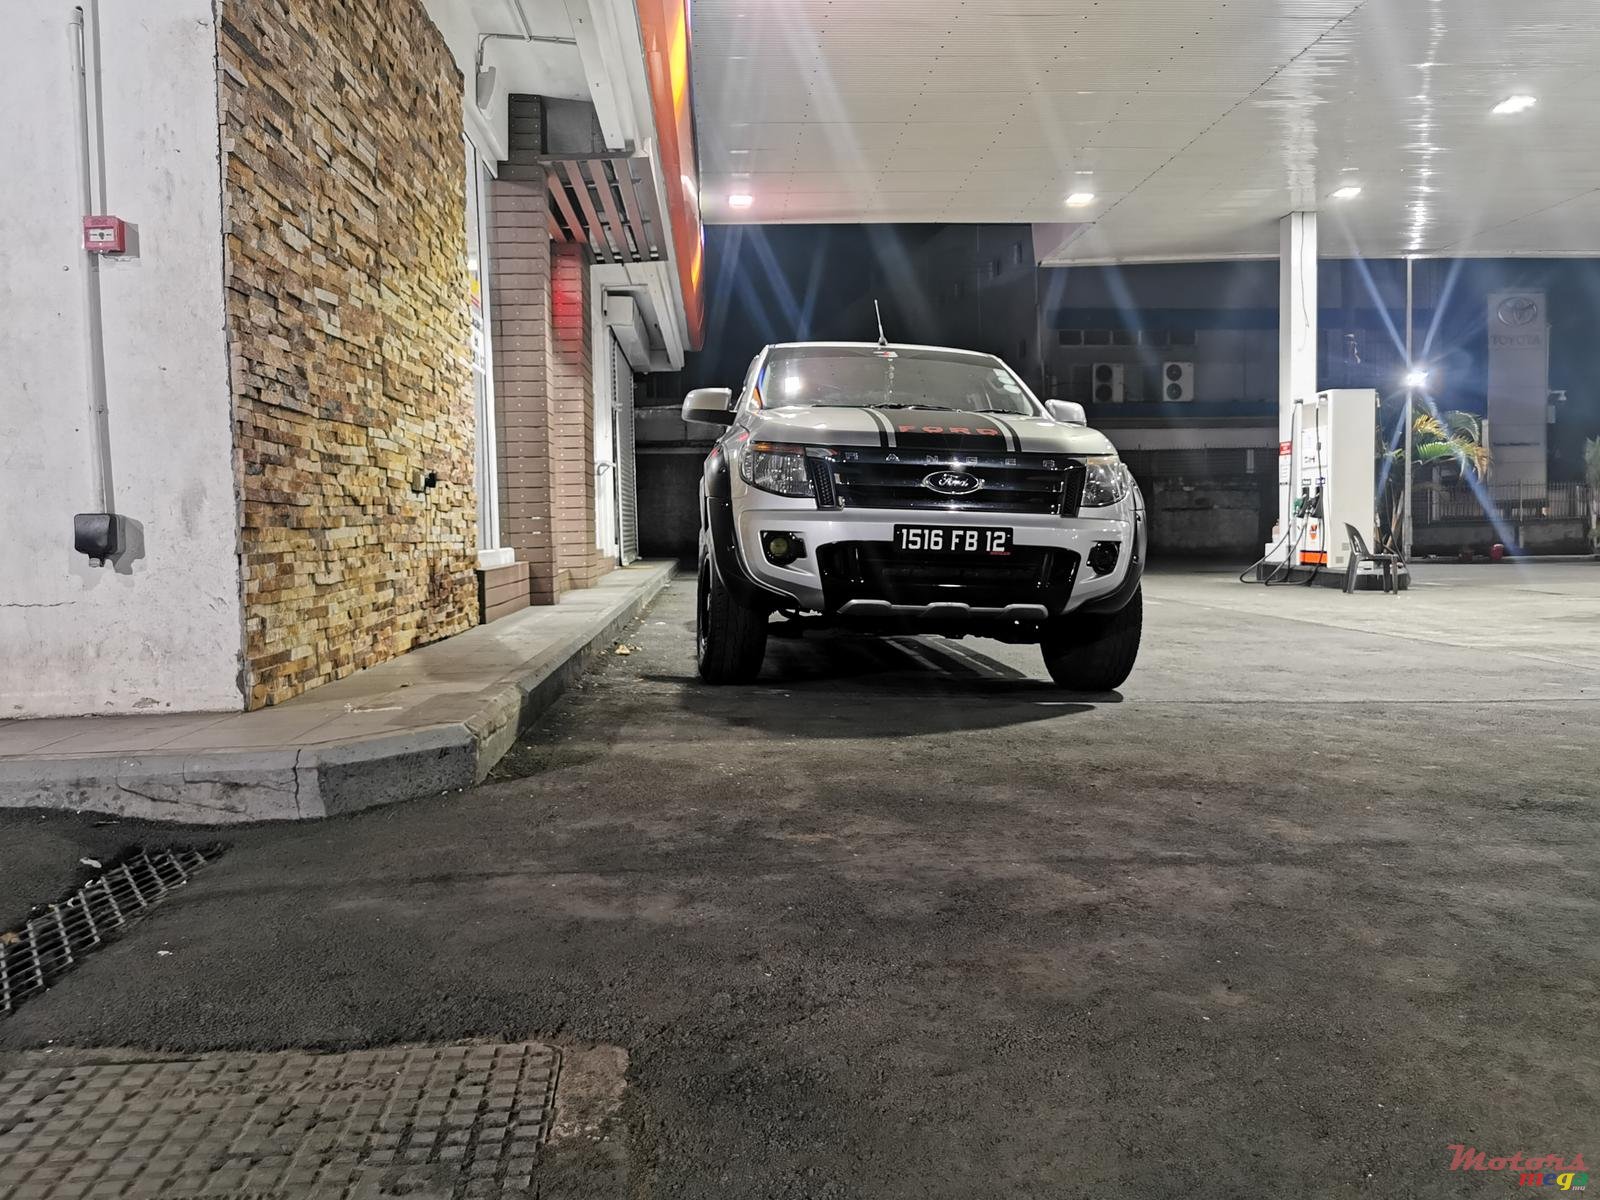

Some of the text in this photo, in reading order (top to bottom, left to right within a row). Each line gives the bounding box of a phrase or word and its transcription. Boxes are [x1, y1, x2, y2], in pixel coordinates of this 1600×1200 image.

[1490, 334, 1542, 346] TOYOTA
[898, 425, 1001, 436] FORD
[844, 451, 1057, 469] RANGER
[901, 528, 1006, 552] 1516 FB 12
